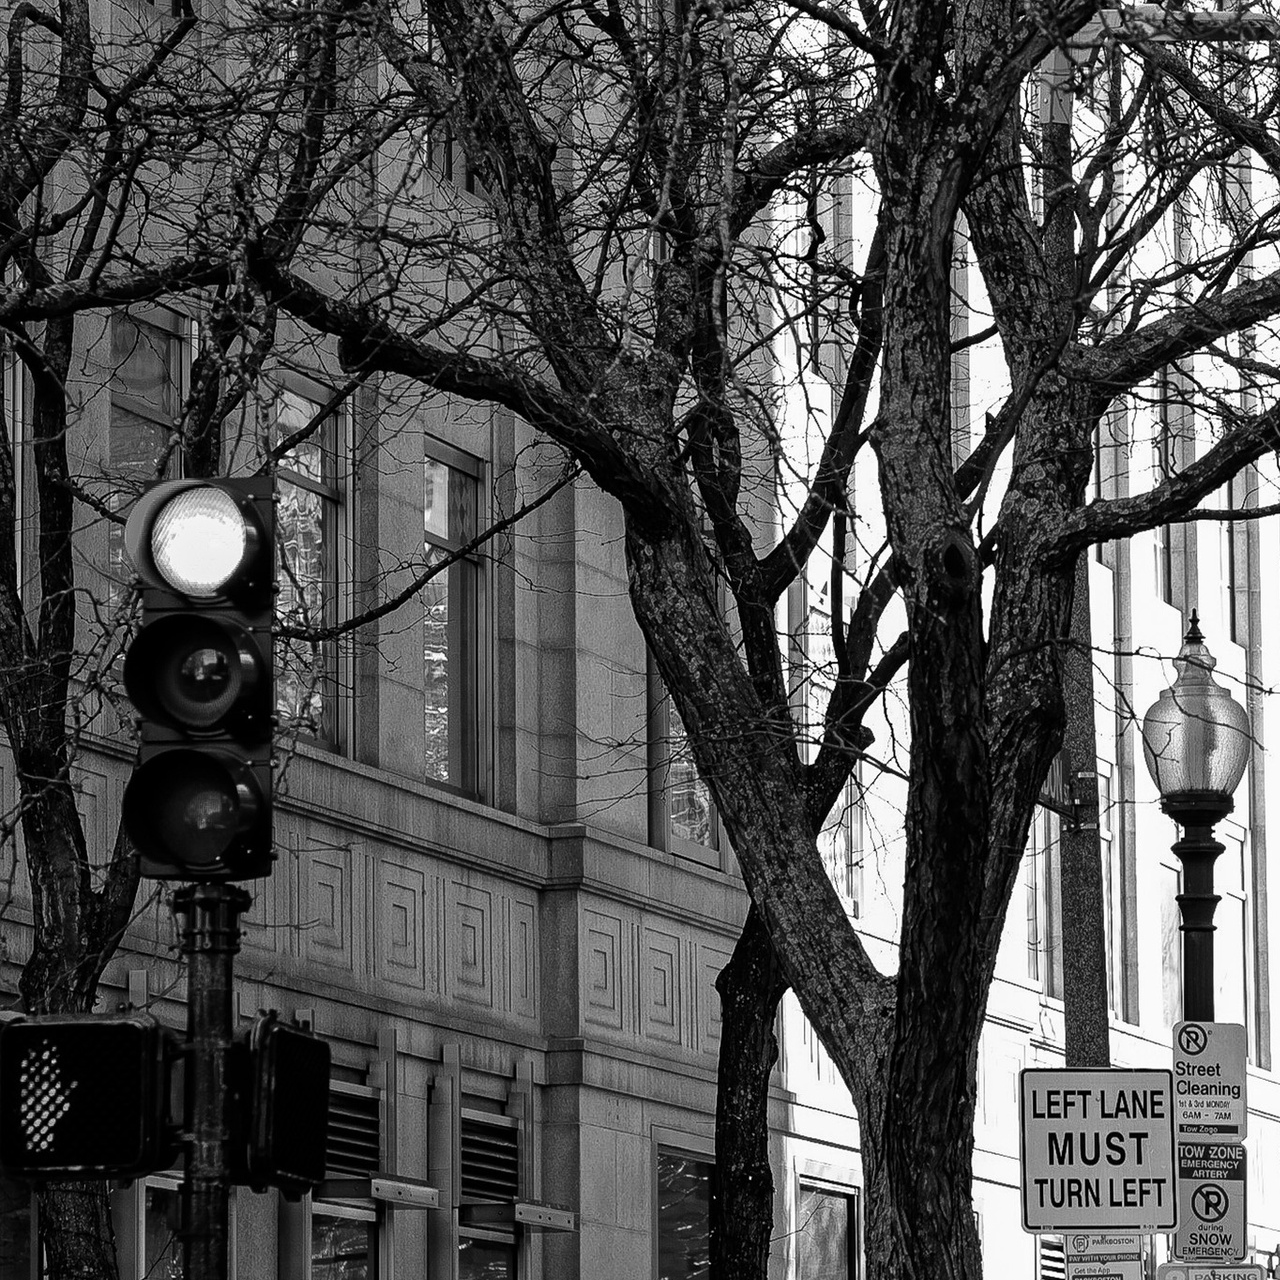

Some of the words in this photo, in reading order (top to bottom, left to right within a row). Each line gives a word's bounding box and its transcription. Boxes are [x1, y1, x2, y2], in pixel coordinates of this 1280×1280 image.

[1175, 1061, 1221, 1077] Street
[1176, 1079, 1241, 1099] Cleaning
[1032, 1090, 1092, 1119] LEFT
[1100, 1090, 1165, 1119] LANE
[1206, 1100, 1231, 1109] MONDAY
[1182, 1110, 1202, 1119] 6AM
[1214, 1112, 1232, 1120] 7AM
[1182, 1125, 1198, 1133] Tow
[1047, 1131, 1149, 1166] MUST
[1179, 1145, 1205, 1158] TOW
[1210, 1146, 1243, 1159] ZONE
[1181, 1159, 1239, 1169] EMERGENCY
[1192, 1169, 1229, 1179] ARTERY
[1034, 1178, 1100, 1208] TURN
[1109, 1178, 1167, 1208] LEFT
[1198, 1224, 1224, 1232] during
[1189, 1232, 1232, 1245] SNOW
[1182, 1246, 1239, 1256] EMERGENCY
[1098, 1267, 1110, 1275] App
